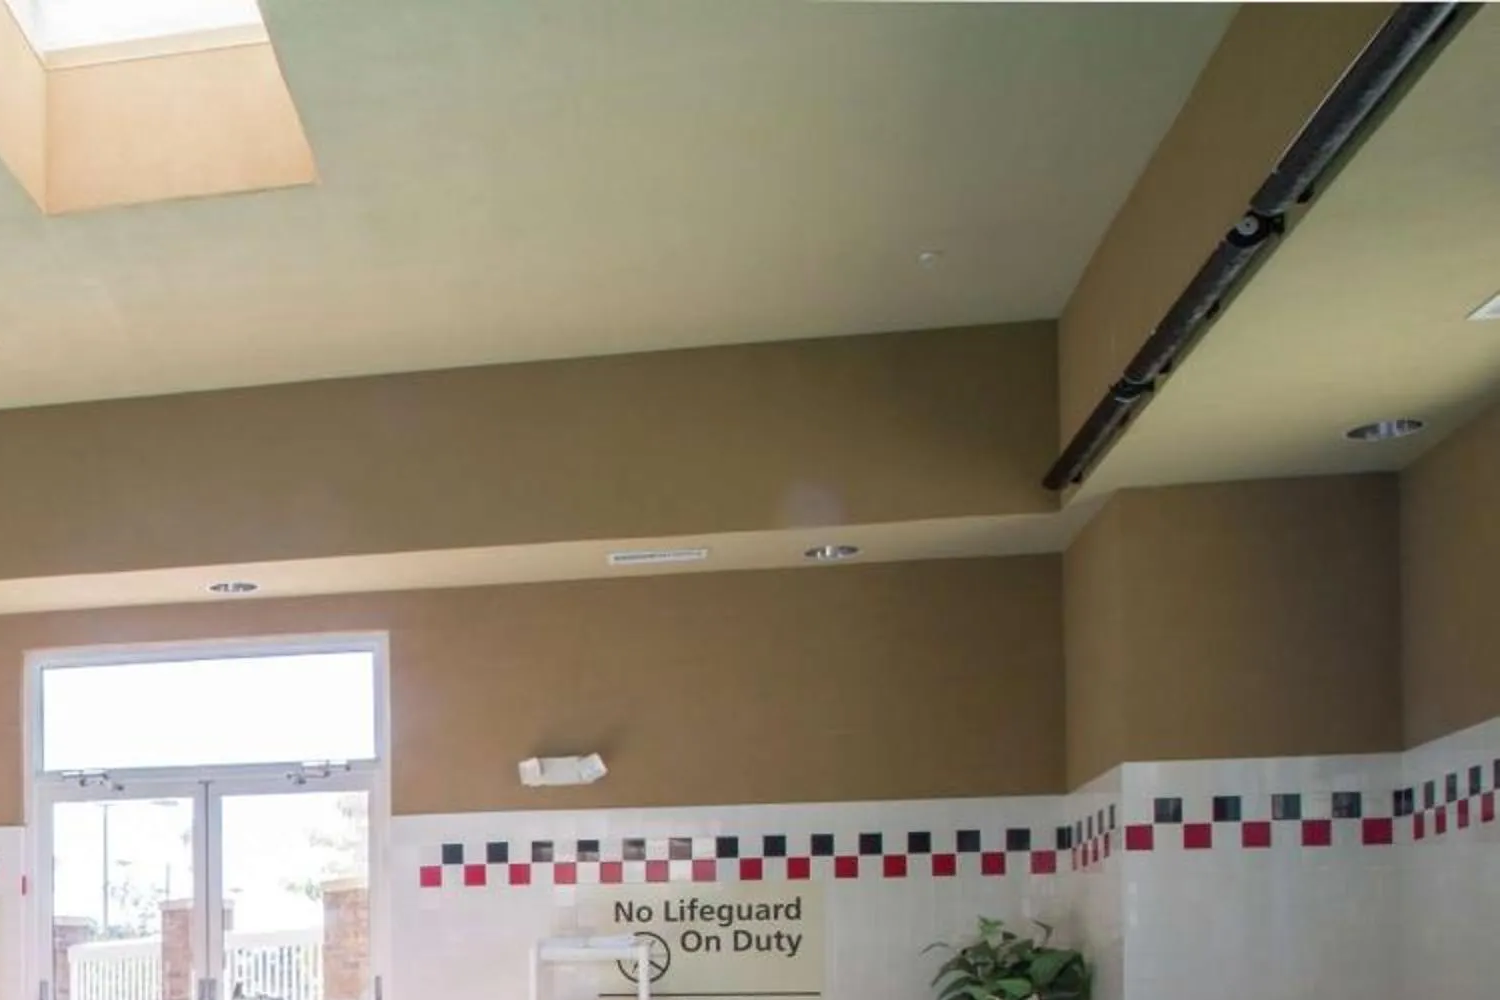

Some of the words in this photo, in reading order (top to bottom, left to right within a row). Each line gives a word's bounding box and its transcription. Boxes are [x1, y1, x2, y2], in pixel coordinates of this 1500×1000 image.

[614, 901, 653, 923] No
[664, 897, 801, 927] Lifeguard
[680, 930, 721, 952] On
[733, 929, 802, 957] Duty
